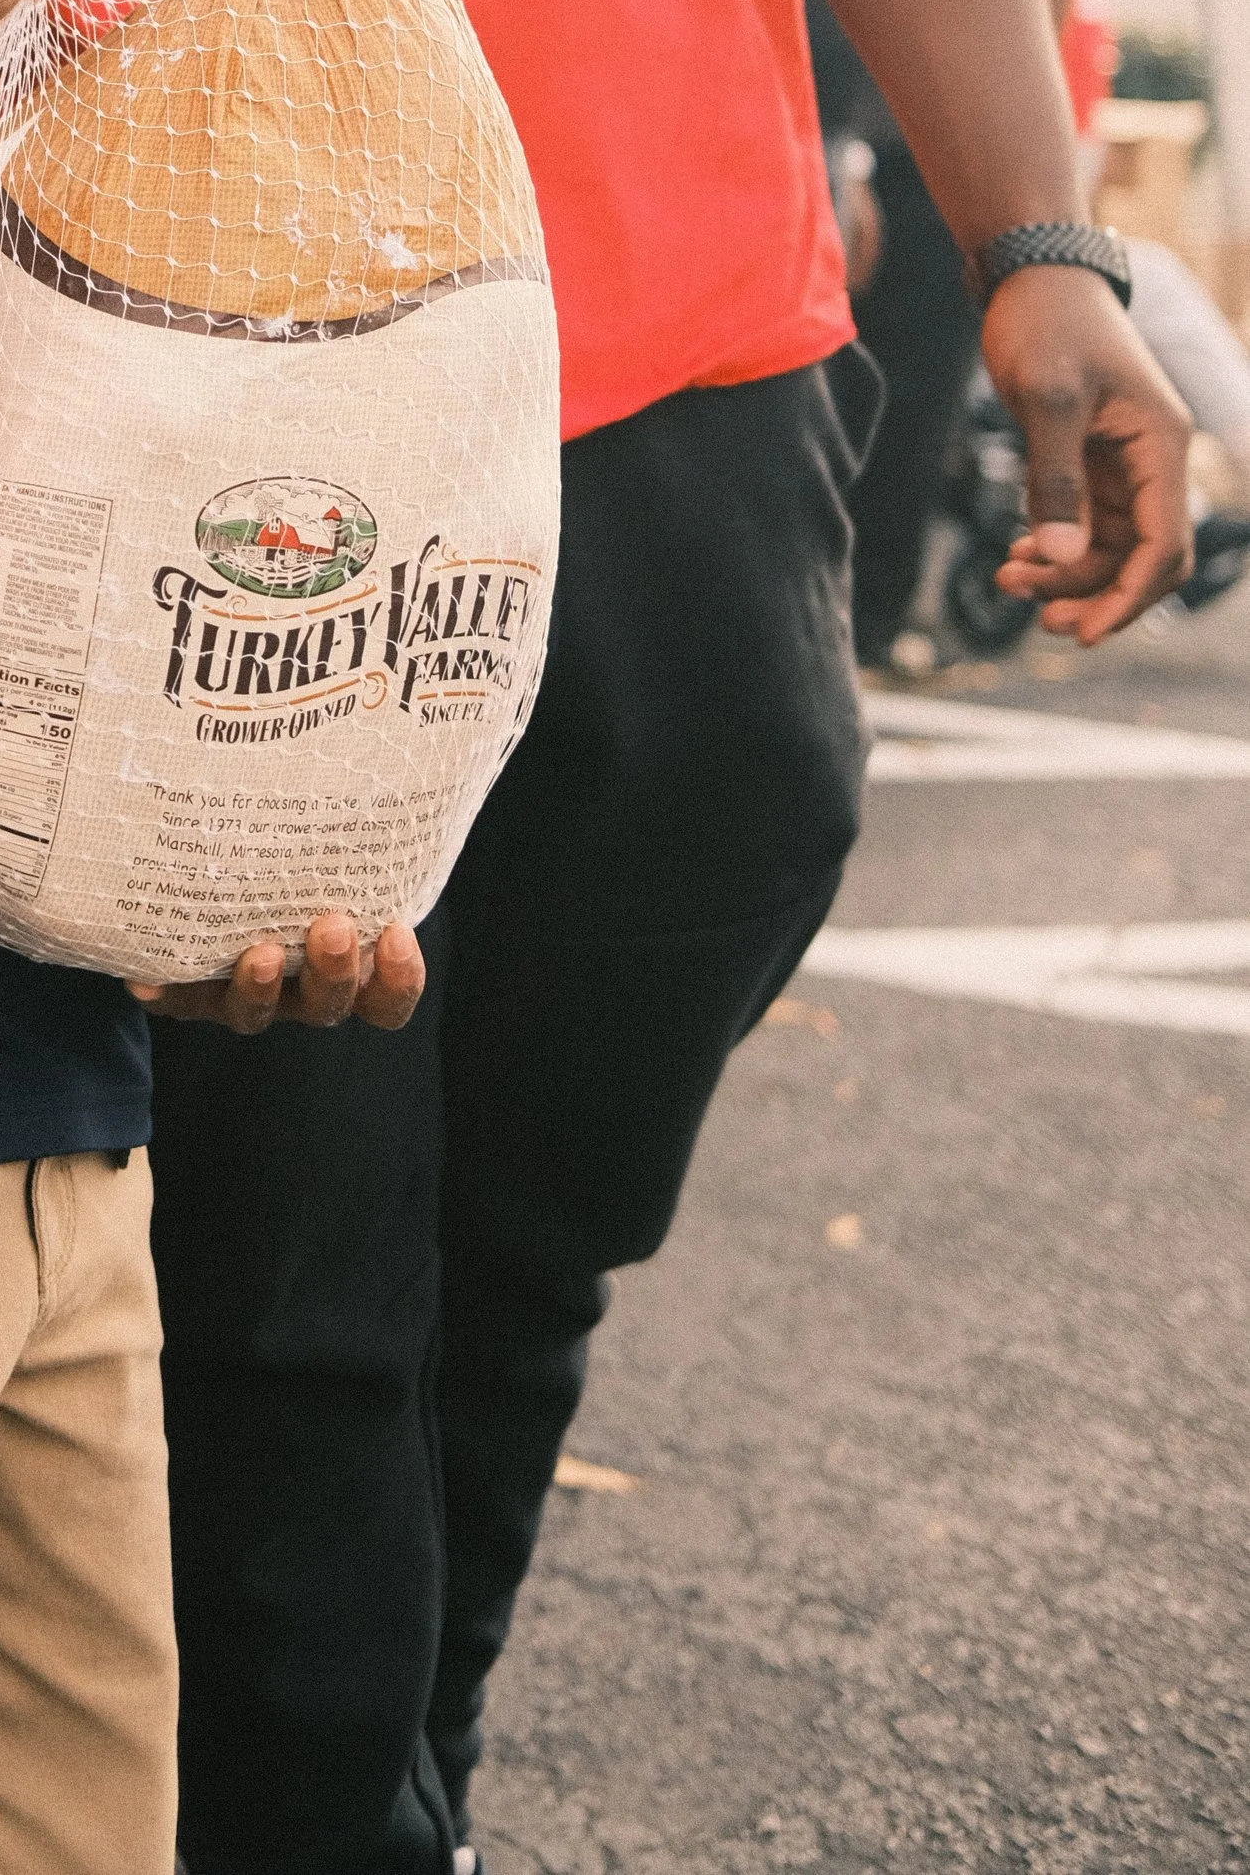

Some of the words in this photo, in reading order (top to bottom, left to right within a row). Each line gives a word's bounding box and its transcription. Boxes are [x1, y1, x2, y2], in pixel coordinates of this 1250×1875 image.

[152, 565, 383, 709] TURKEY
[35, 677, 81, 696] Facts
[399, 649, 517, 713] FARMS
[196, 694, 357, 744] GROWER-OWNED
[40, 724, 72, 740] 150
[200, 795, 226, 810] you
[232, 793, 252, 809] for
[256, 795, 307, 815] choosing
[325, 795, 360, 810] Turke
[162, 811, 200, 828] Since
[248, 823, 270, 834] our
[156, 833, 224, 859] Marshall,
[230, 844, 294, 860] Minnesota,
[322, 843, 349, 855] been
[344, 863, 382, 879] turkey
[126, 879, 152, 891] our
[156, 882, 235, 902] Midwestern
[239, 888, 274, 903] farms
[279, 888, 290, 899] to
[295, 887, 320, 899] your
[116, 898, 142, 912] not
[146, 903, 164, 915] be
[170, 907, 190, 921] the
[196, 909, 243, 928] biggest
[247, 908, 282, 922] turkey
[221, 933, 232, 943] in
[146, 945, 176, 959] with
